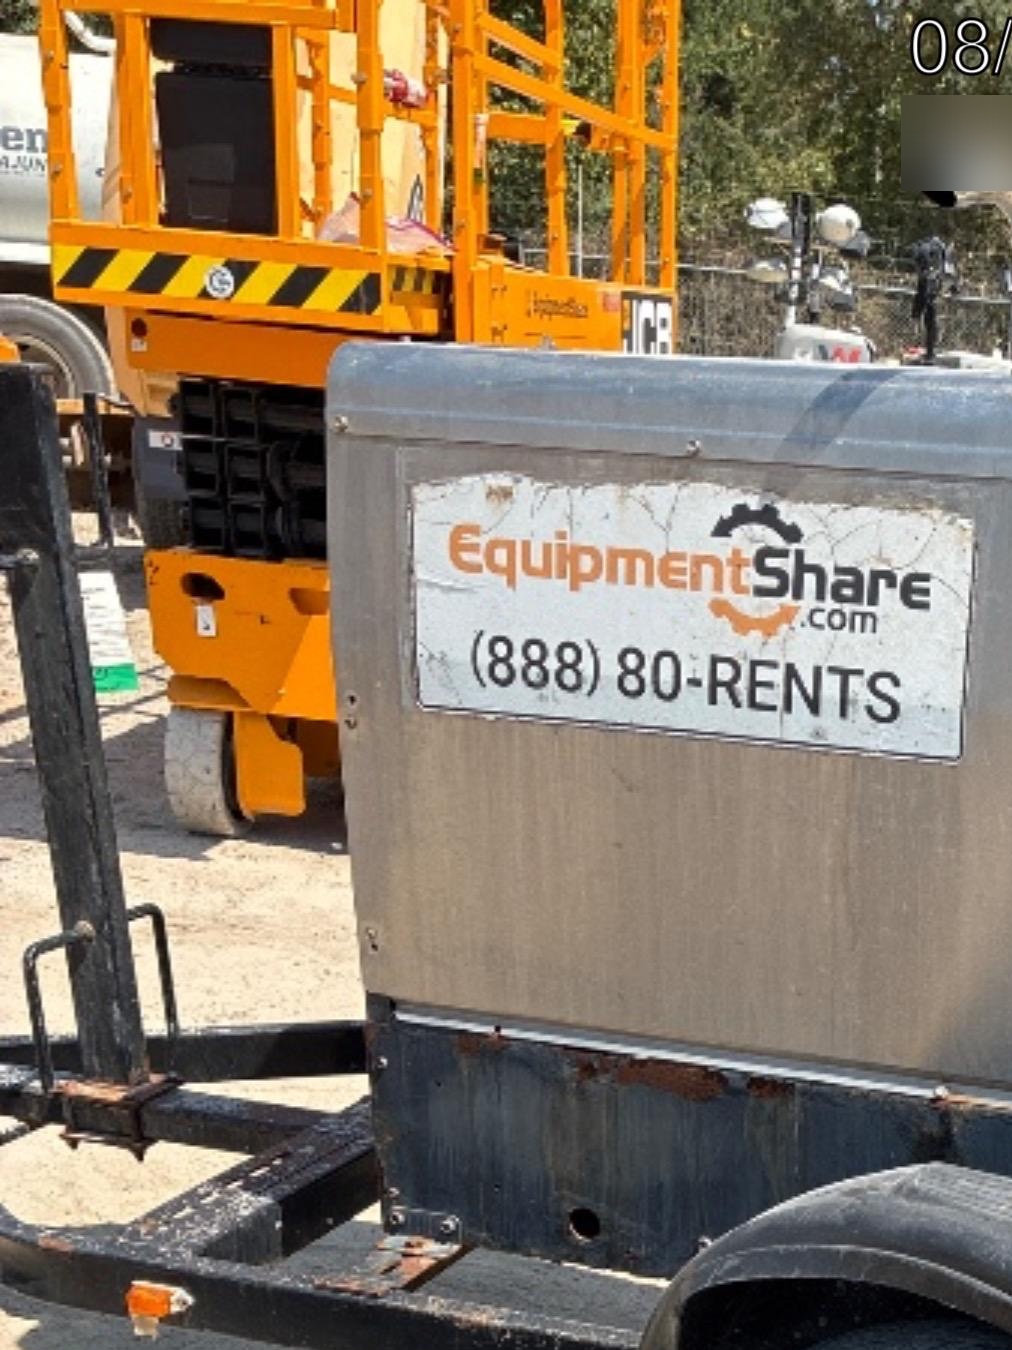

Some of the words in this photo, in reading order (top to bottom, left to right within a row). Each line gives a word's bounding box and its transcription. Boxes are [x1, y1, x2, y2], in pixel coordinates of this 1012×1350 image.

[448, 523, 931, 611] EquipmentShare
[801, 605, 878, 634] .com
[471, 629, 600, 697] (888)
[617, 646, 903, 724] 80-RENTS
